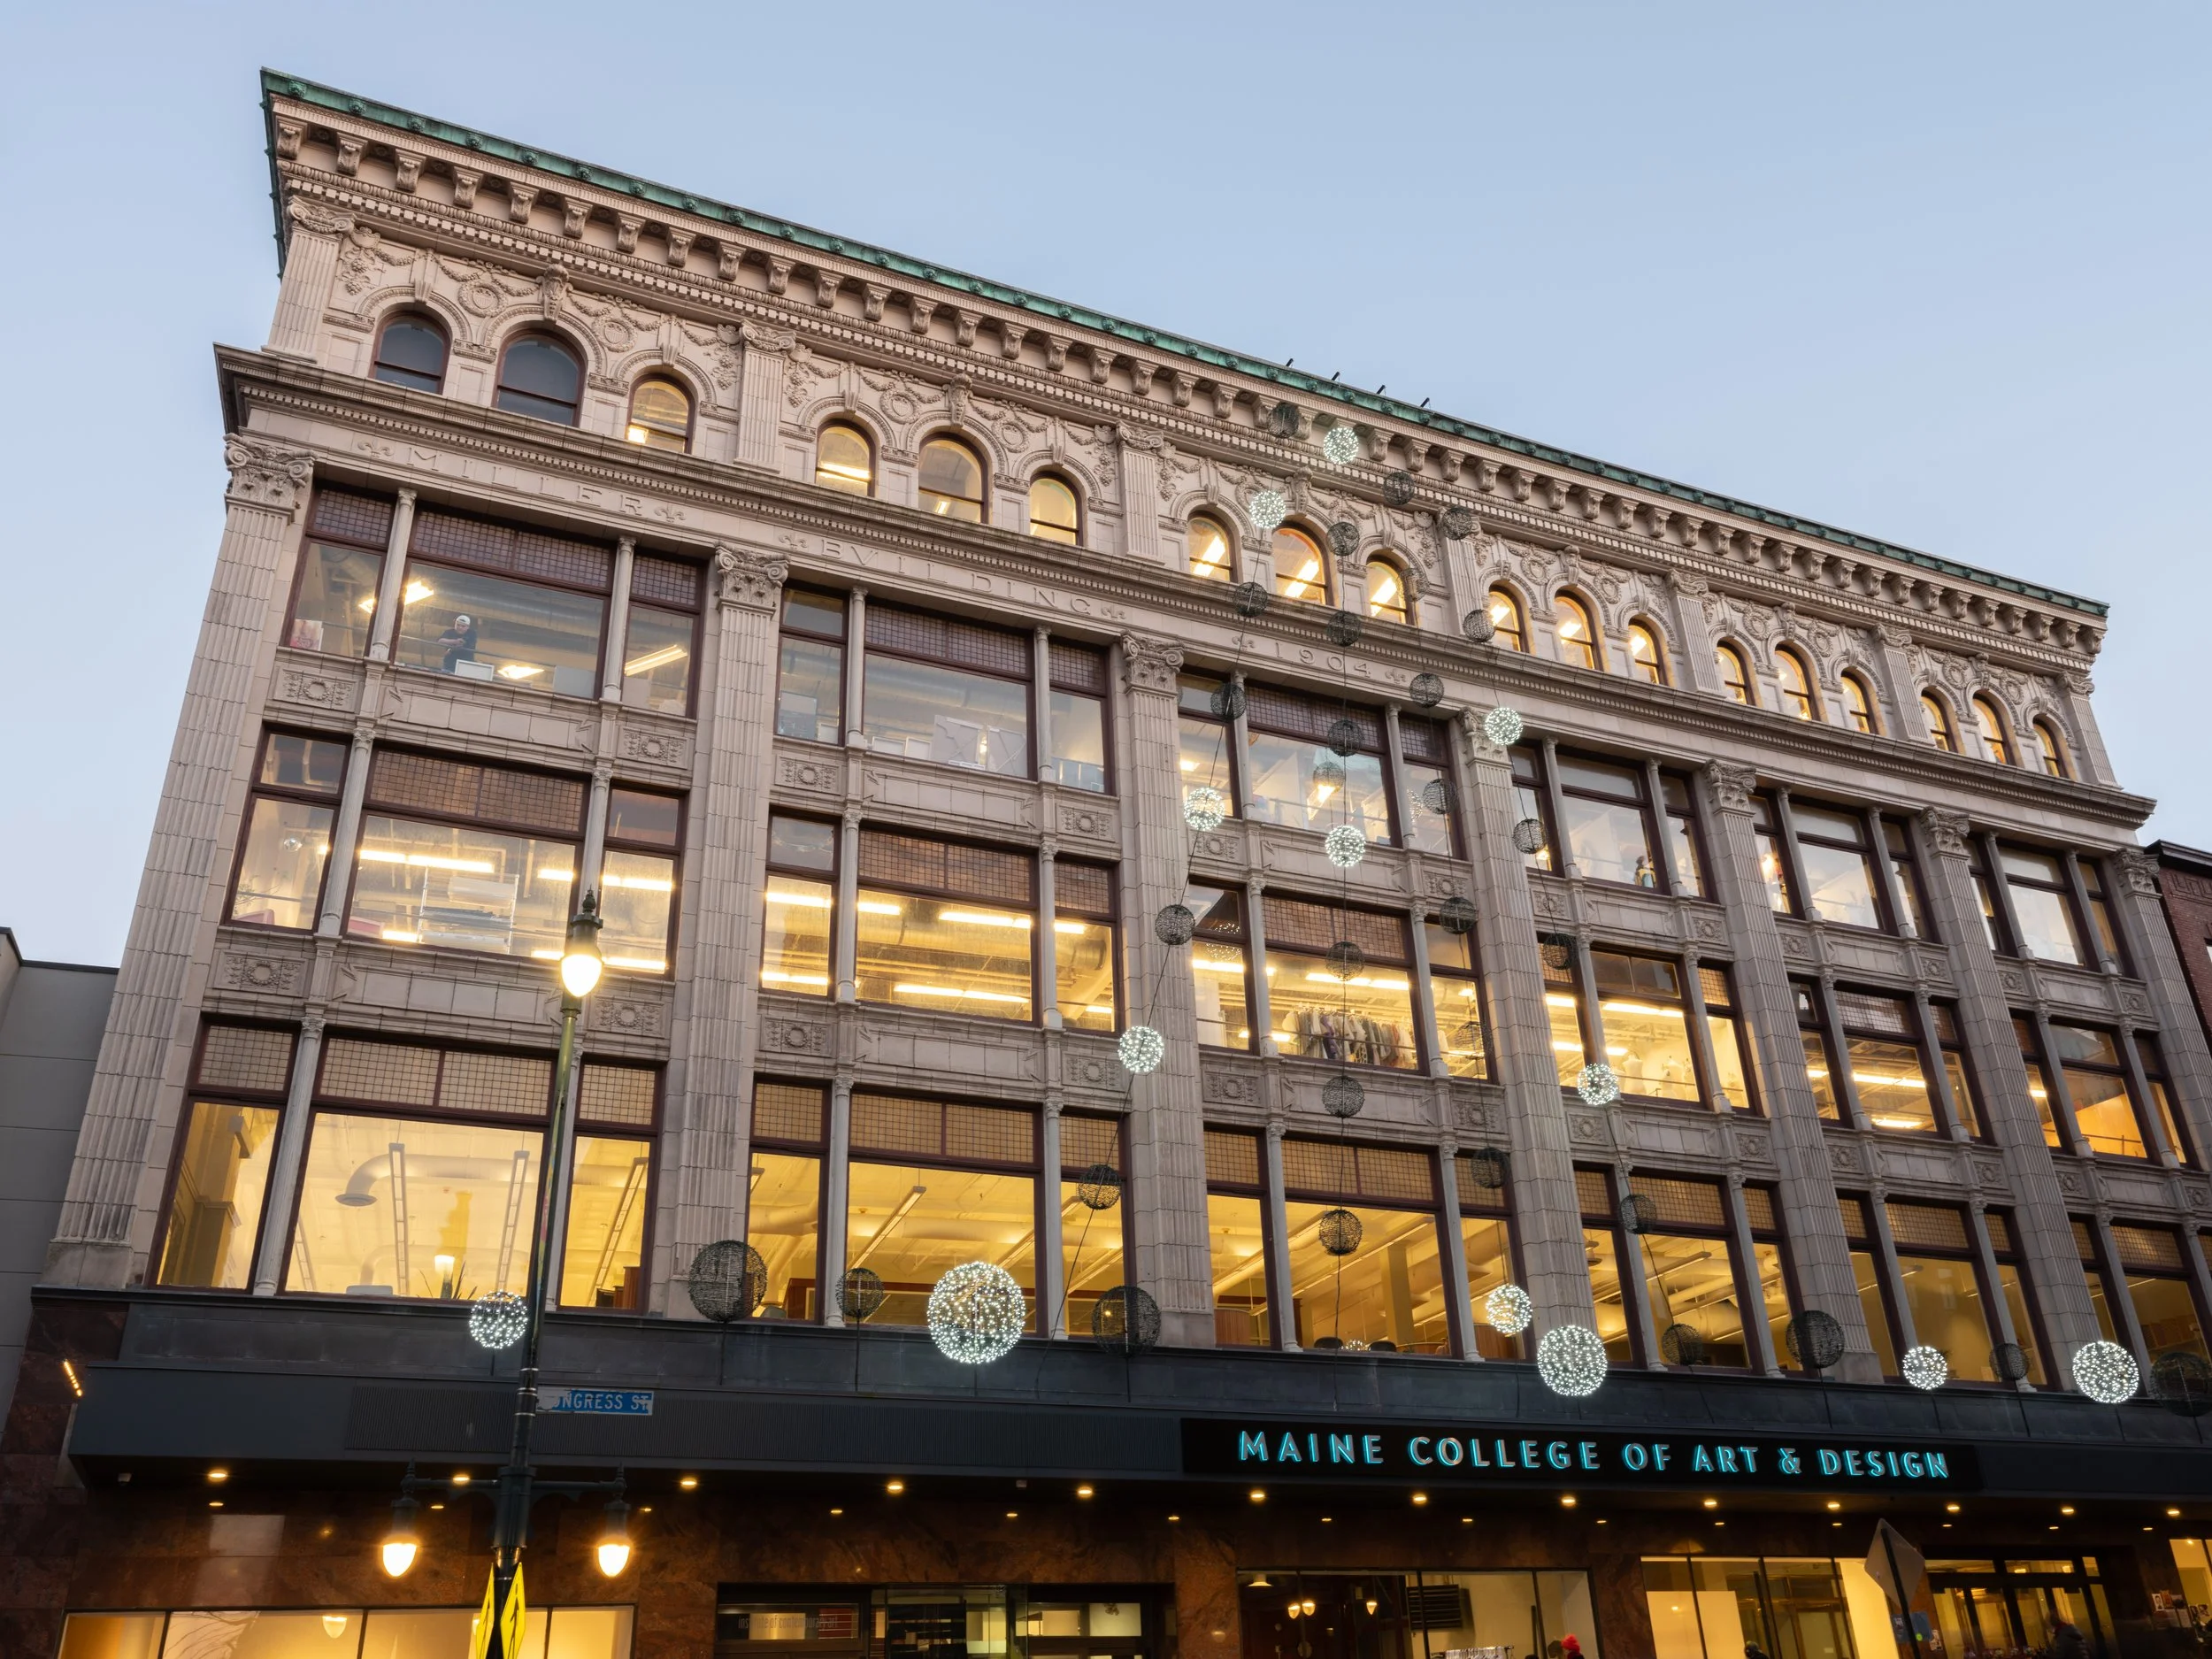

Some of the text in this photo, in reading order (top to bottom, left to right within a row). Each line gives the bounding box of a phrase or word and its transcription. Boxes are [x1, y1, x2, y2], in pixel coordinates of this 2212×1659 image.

[406, 446, 643, 516] MILLER
[1274, 641, 1372, 678] 1904
[553, 1392, 649, 1410] NGRESS ST
[1240, 1430, 1949, 1479] MAINE COLLEGE OF ART & DESIGN
[738, 1615, 768, 1629] instute
